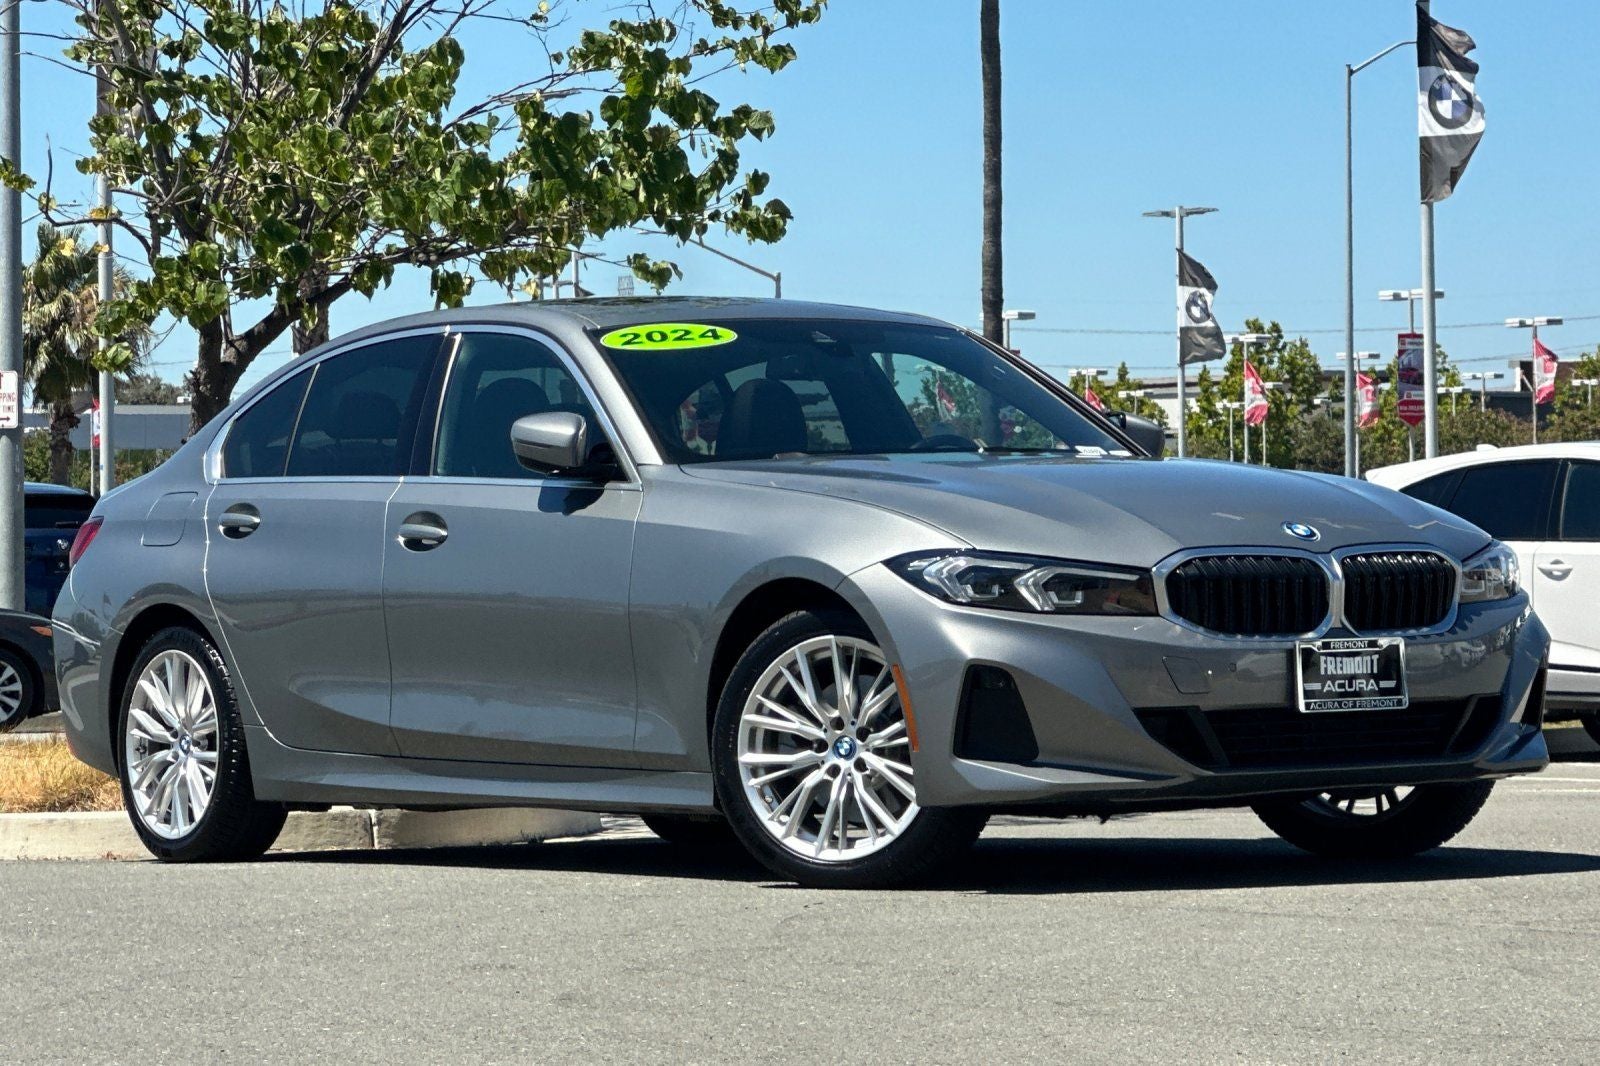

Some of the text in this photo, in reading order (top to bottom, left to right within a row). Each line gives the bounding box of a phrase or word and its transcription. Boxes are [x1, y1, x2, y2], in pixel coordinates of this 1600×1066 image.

[620, 328, 723, 346] 2024
[1330, 640, 1368, 649] FREMONT
[1320, 654, 1379, 675] FREMONT
[1323, 679, 1378, 692] ACURA
[1310, 699, 1398, 710] ACURA OF FREMONT
